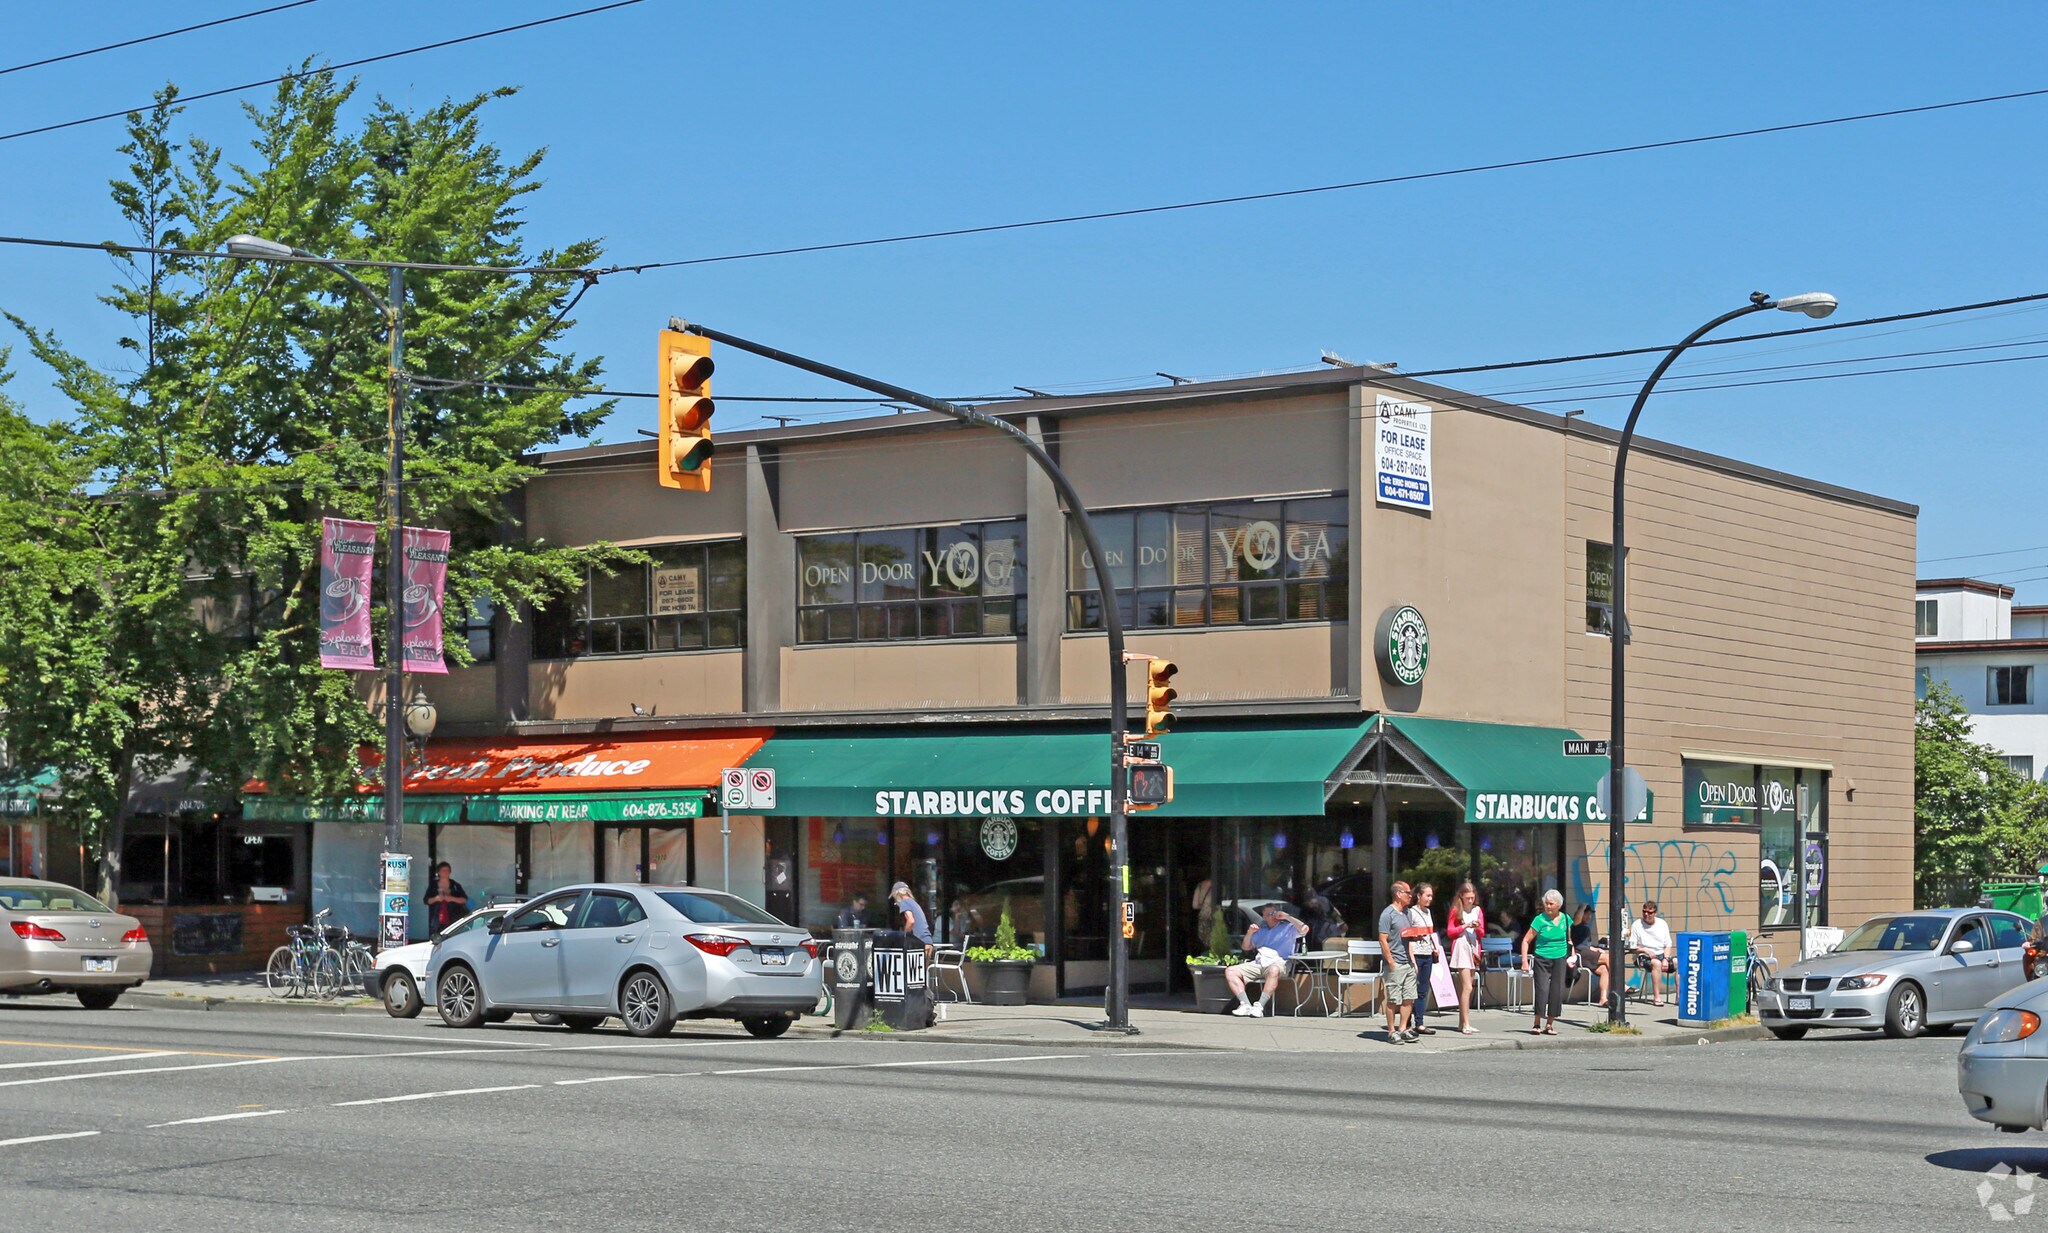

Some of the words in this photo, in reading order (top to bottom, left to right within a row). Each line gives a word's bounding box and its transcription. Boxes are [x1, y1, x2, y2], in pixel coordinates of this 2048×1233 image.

[1393, 404, 1418, 420] CAMY
[1381, 430, 1398, 445] FOR
[1400, 434, 1426, 451] LEASE
[1384, 445, 1404, 458] OFFICE
[1405, 450, 1423, 461] SPACE
[1381, 456, 1427, 478] 604-267-0602
[1216, 520, 1332, 574] YOGA
[1590, 571, 1613, 587] OPEN
[1391, 611, 1427, 645] STARBUCKS
[340, 643, 365, 657] EAT
[403, 635, 434, 654] xplore
[414, 649, 436, 661] EAT
[1395, 660, 1424, 682] COFFEE
[1129, 744, 1134, 757] E
[1136, 745, 1144, 757] 14
[1568, 742, 1590, 754] MAIN
[492, 754, 651, 779] Produce
[875, 790, 1025, 815] STARBUCKS
[1761, 779, 1795, 815] YOGA
[499, 804, 544, 820] PARKING
[546, 804, 560, 819] AT
[562, 803, 589, 820] REAR
[622, 802, 698, 818] 604-876-5354
[1475, 793, 1580, 821] STARBUCKS
[982, 815, 1016, 835] STARBUCKS
[244, 835, 263, 845] OPEN
[985, 845, 1011, 858] COFFEE
[387, 861, 407, 869] RUSH
[1688, 939, 1701, 962] The
[1687, 963, 1701, 1016] Province
